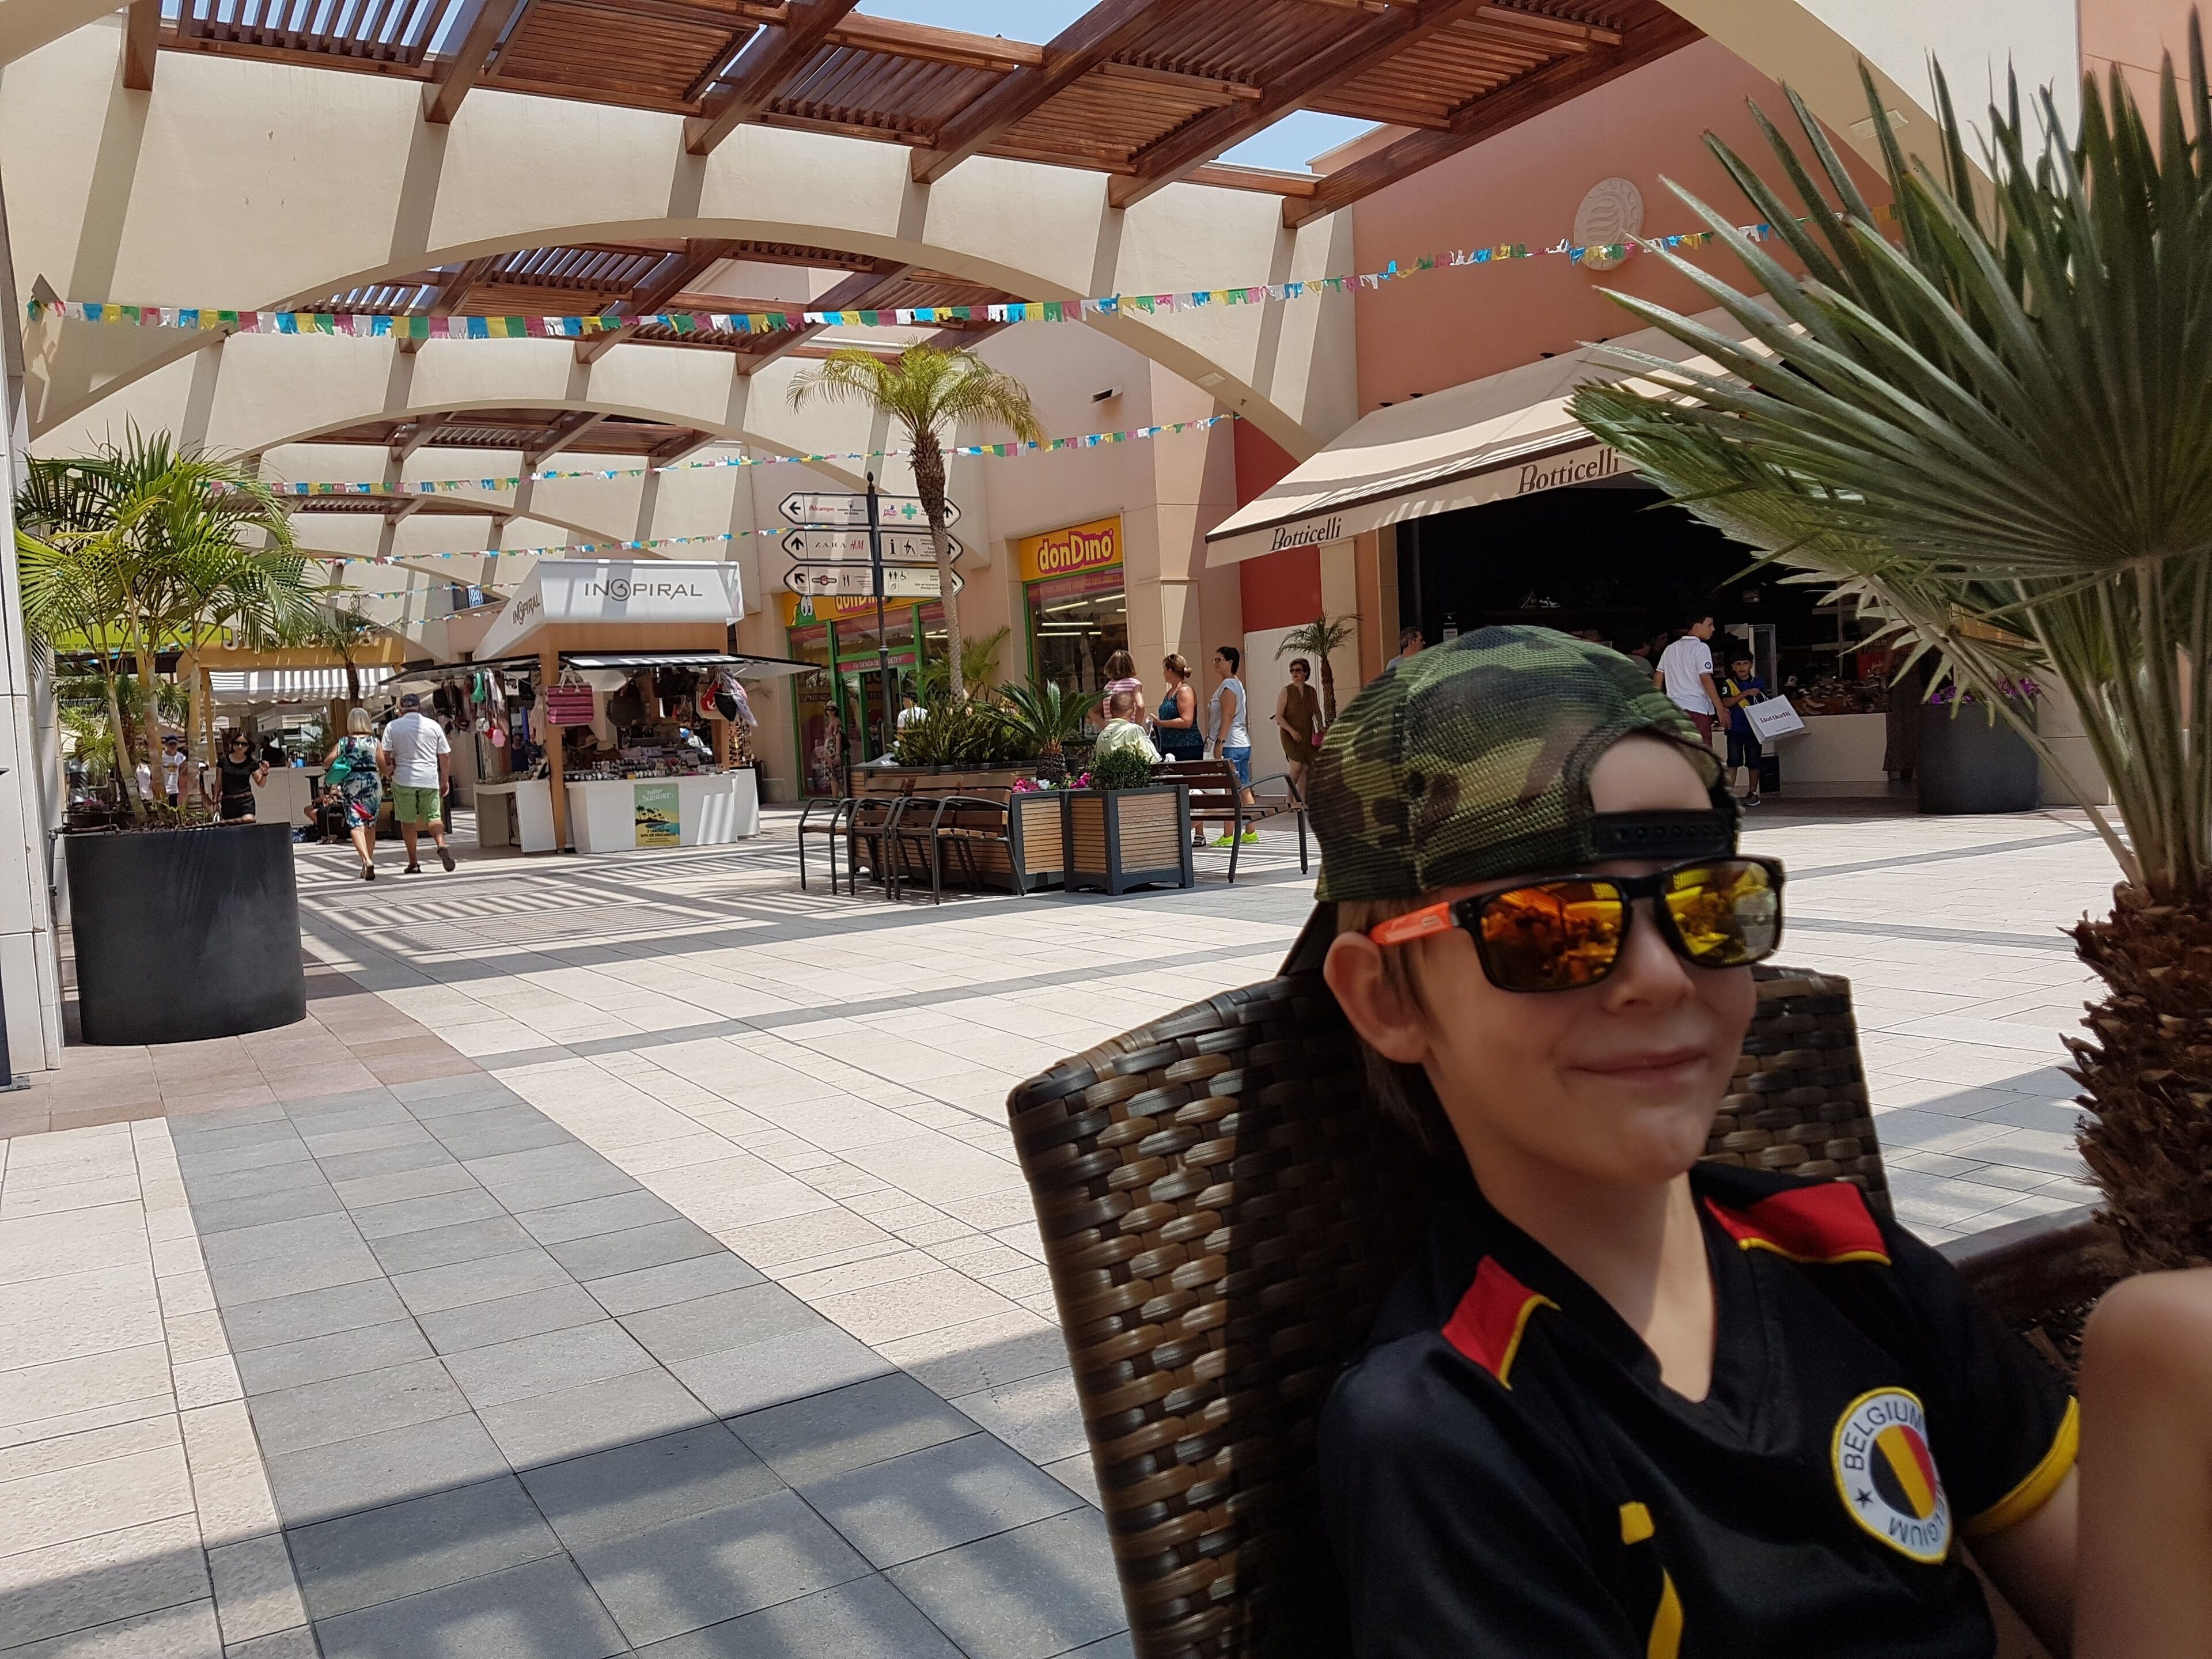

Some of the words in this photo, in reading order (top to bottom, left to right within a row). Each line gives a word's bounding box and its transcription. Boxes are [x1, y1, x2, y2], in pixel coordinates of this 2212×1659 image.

[1516, 447, 1620, 495] Botticelli
[809, 505, 834, 513] Alcampo
[1269, 517, 1342, 552] Botticelli
[1039, 535, 1112, 570] donDino
[585, 578, 703, 601] INSPIRAL
[512, 593, 541, 626] INSPIRAL
[1721, 686, 1728, 695] 3
[1844, 1400, 1921, 1471] BELGIUM
